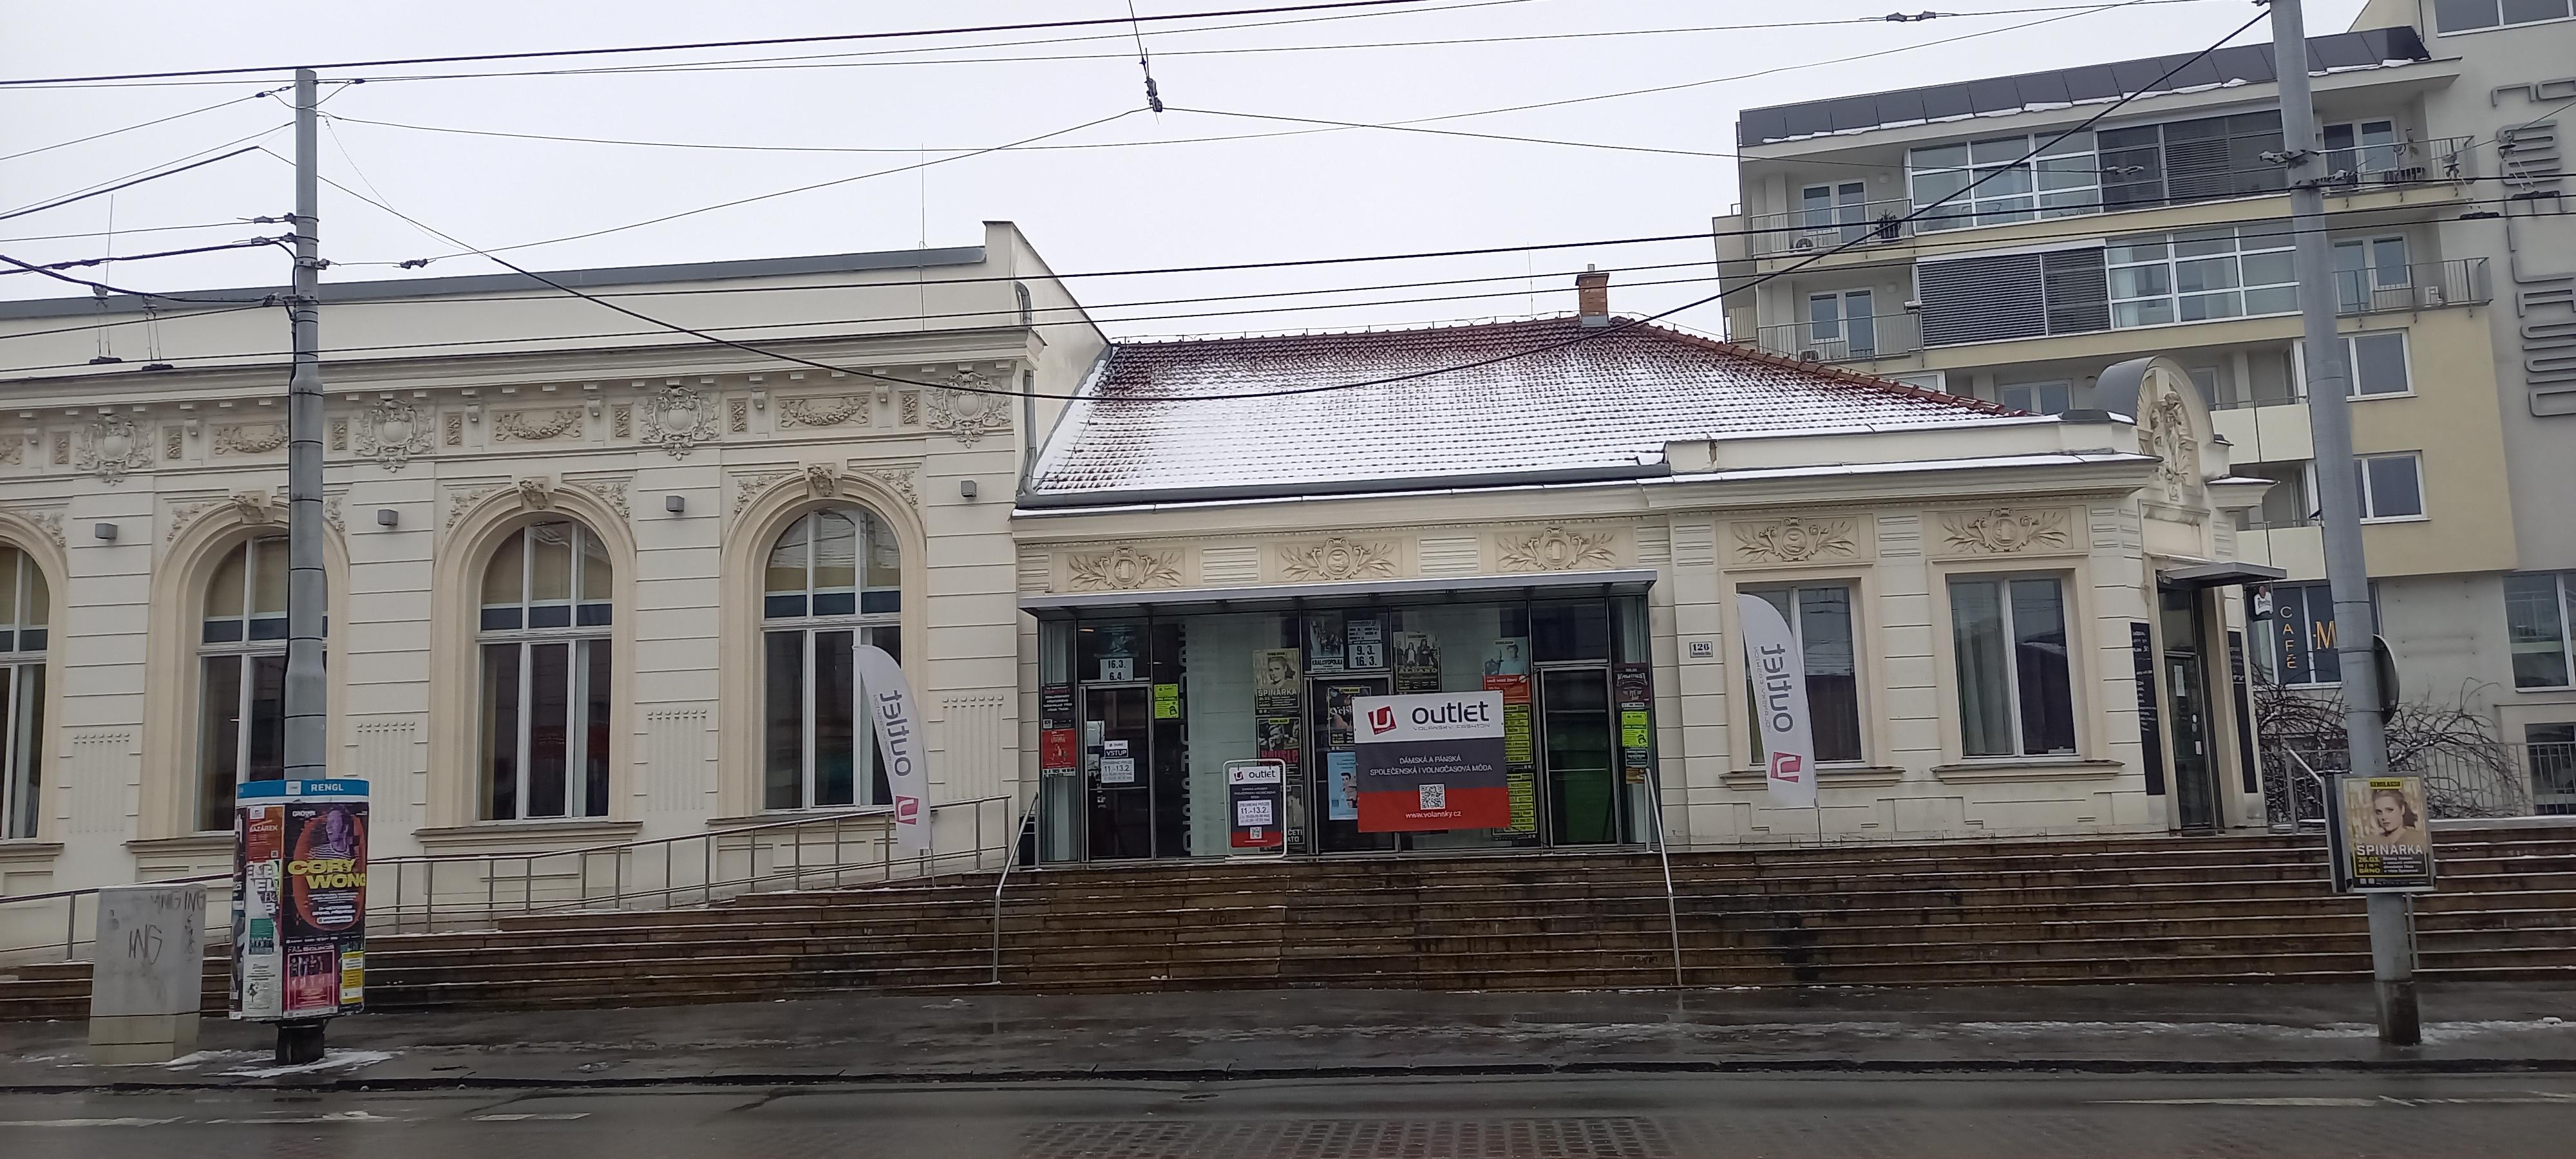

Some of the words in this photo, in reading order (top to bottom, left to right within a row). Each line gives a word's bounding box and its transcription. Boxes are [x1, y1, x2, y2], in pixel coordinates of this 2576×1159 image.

[1108, 660, 1126, 669] 16.3.
[1412, 701, 1490, 724] outlet
[1434, 754, 1462, 763] PÁNSKÁ
[1249, 770, 1276, 778] outlet
[310, 783, 345, 792] RENGL
[2356, 842, 2423, 856] ŠPINARKA
[287, 858, 356, 875] CORY
